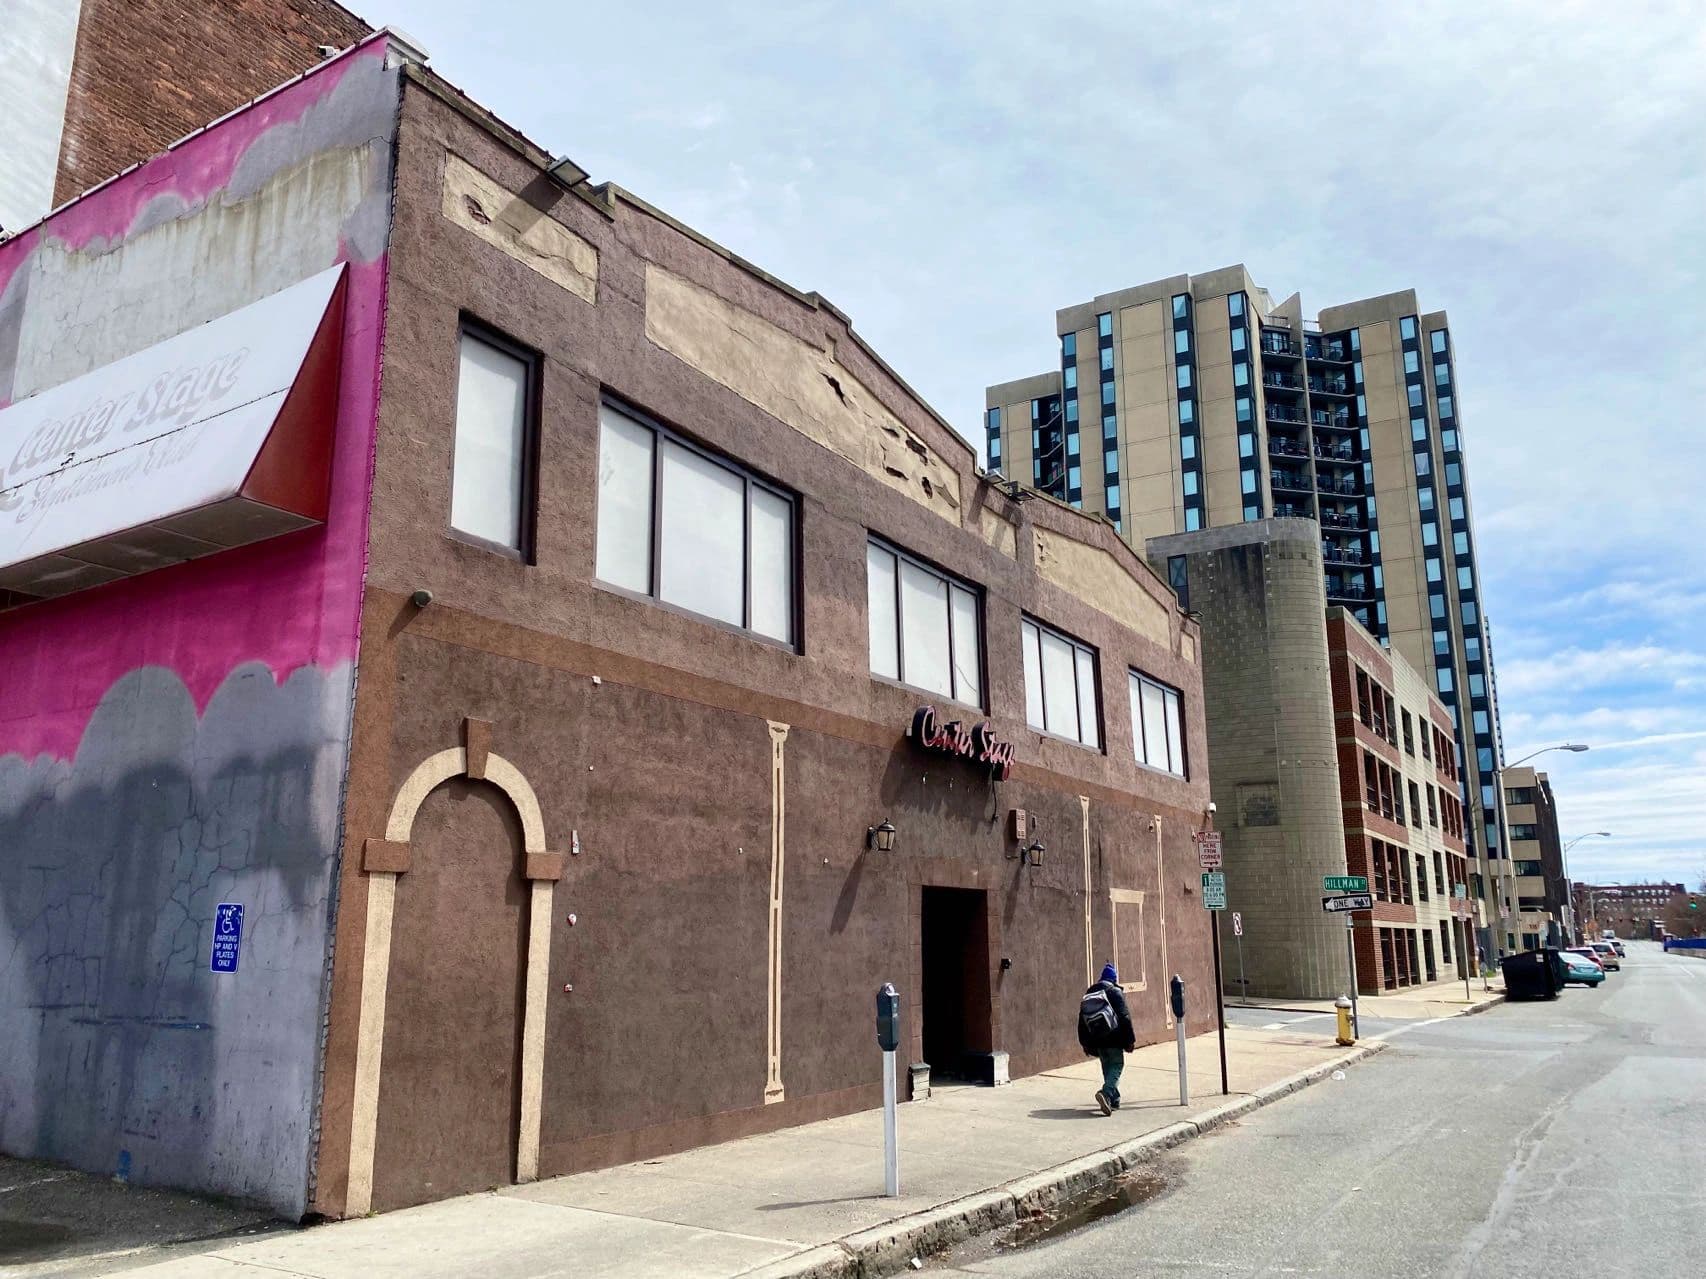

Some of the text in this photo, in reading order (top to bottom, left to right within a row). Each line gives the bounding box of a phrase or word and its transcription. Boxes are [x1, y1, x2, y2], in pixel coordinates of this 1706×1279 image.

[123, 346, 250, 432] Stage
[1325, 879, 1359, 889] HILLMAN
[1334, 897, 1370, 909] ONE WAY
[216, 934, 238, 942] PARKING
[216, 951, 234, 959] PLATES
